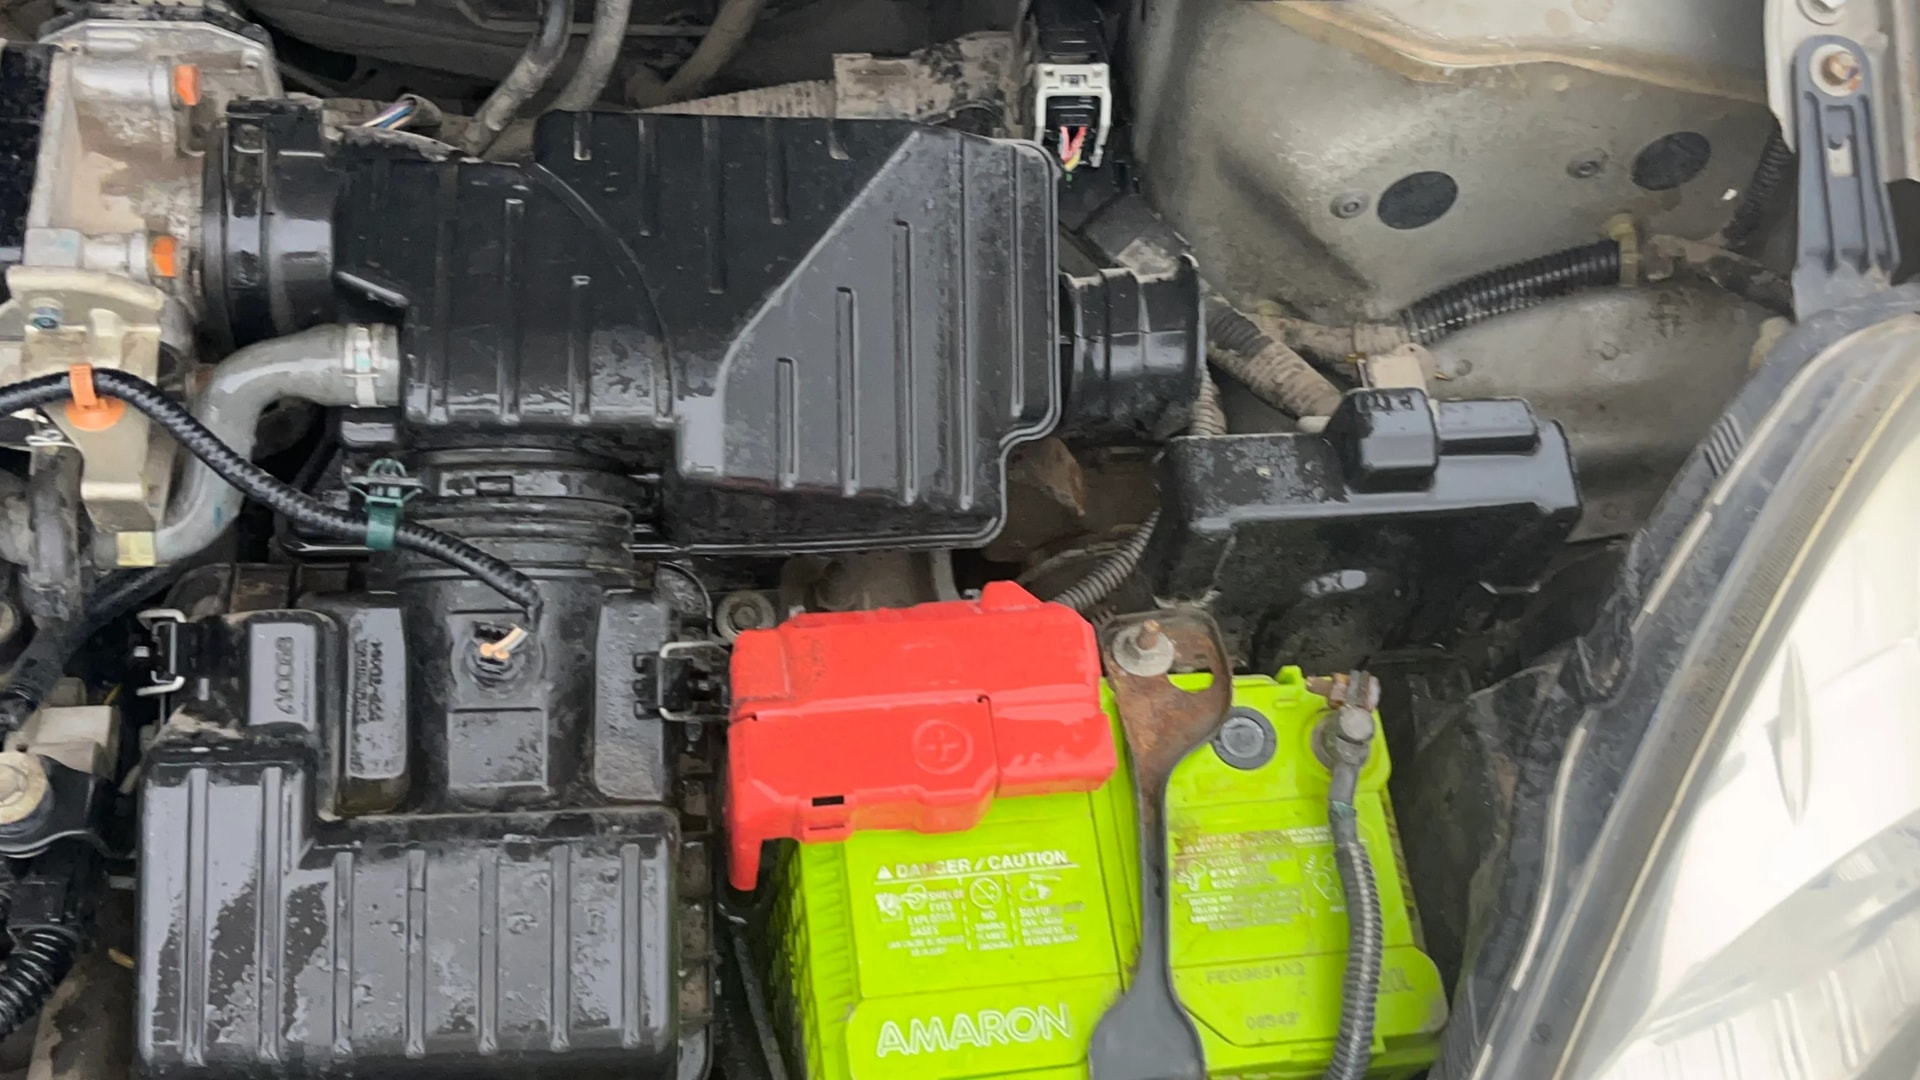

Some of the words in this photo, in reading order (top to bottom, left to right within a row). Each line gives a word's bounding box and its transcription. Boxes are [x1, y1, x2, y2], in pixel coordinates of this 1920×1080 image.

[895, 858, 971, 879] DANGER
[987, 849, 1069, 870] CAUTION
[980, 910, 997, 920] NO
[876, 1002, 1072, 1058] AMARON
